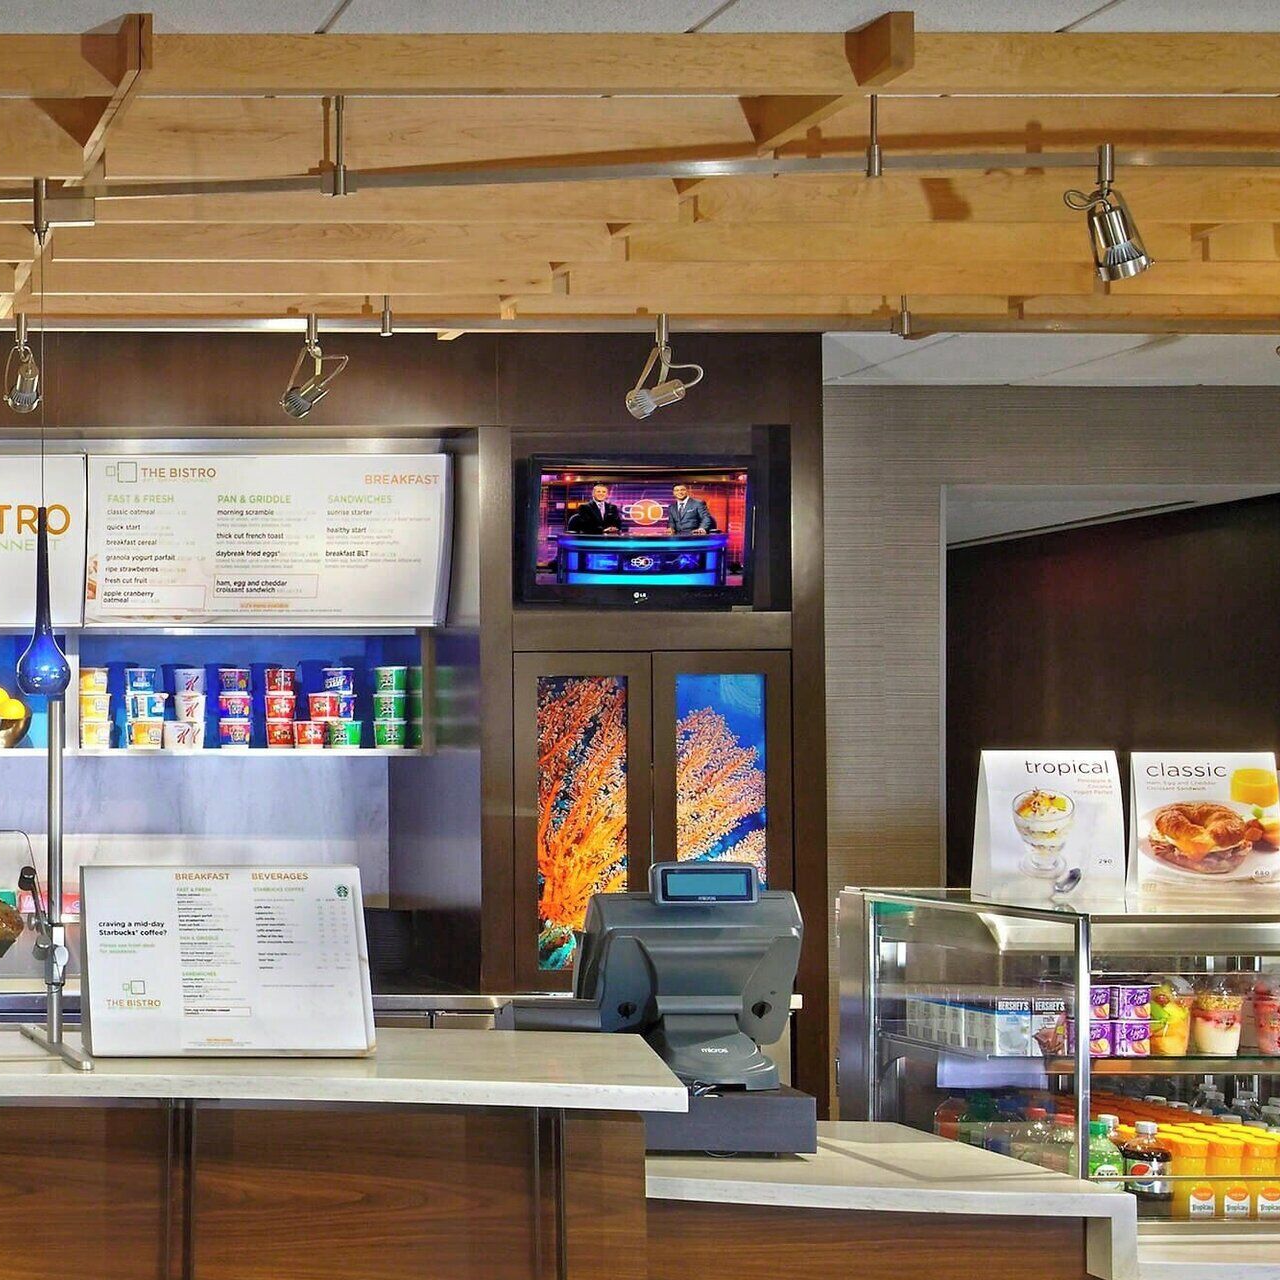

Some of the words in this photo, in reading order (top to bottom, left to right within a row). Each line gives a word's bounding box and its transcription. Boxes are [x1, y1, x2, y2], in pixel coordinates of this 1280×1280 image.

[141, 467, 166, 478] THE
[169, 467, 217, 478] BISTRO
[364, 474, 440, 485] BREAKFAST
[107, 494, 130, 503] FAST
[143, 494, 175, 503] FRESH
[217, 494, 237, 504] PAN
[249, 494, 292, 504] GRIDDLE
[327, 494, 393, 504] SANDWICHES
[1025, 759, 1109, 776] tropical
[1146, 762, 1227, 778] classic
[174, 872, 230, 881] BREAKFAST
[251, 872, 309, 881] BEVERAGES
[106, 999, 124, 1007] THE
[126, 999, 161, 1007] BISTRO
[997, 1001, 1029, 1011] HERSHEY'S
[1035, 1001, 1066, 1011] HERSHEY'S
